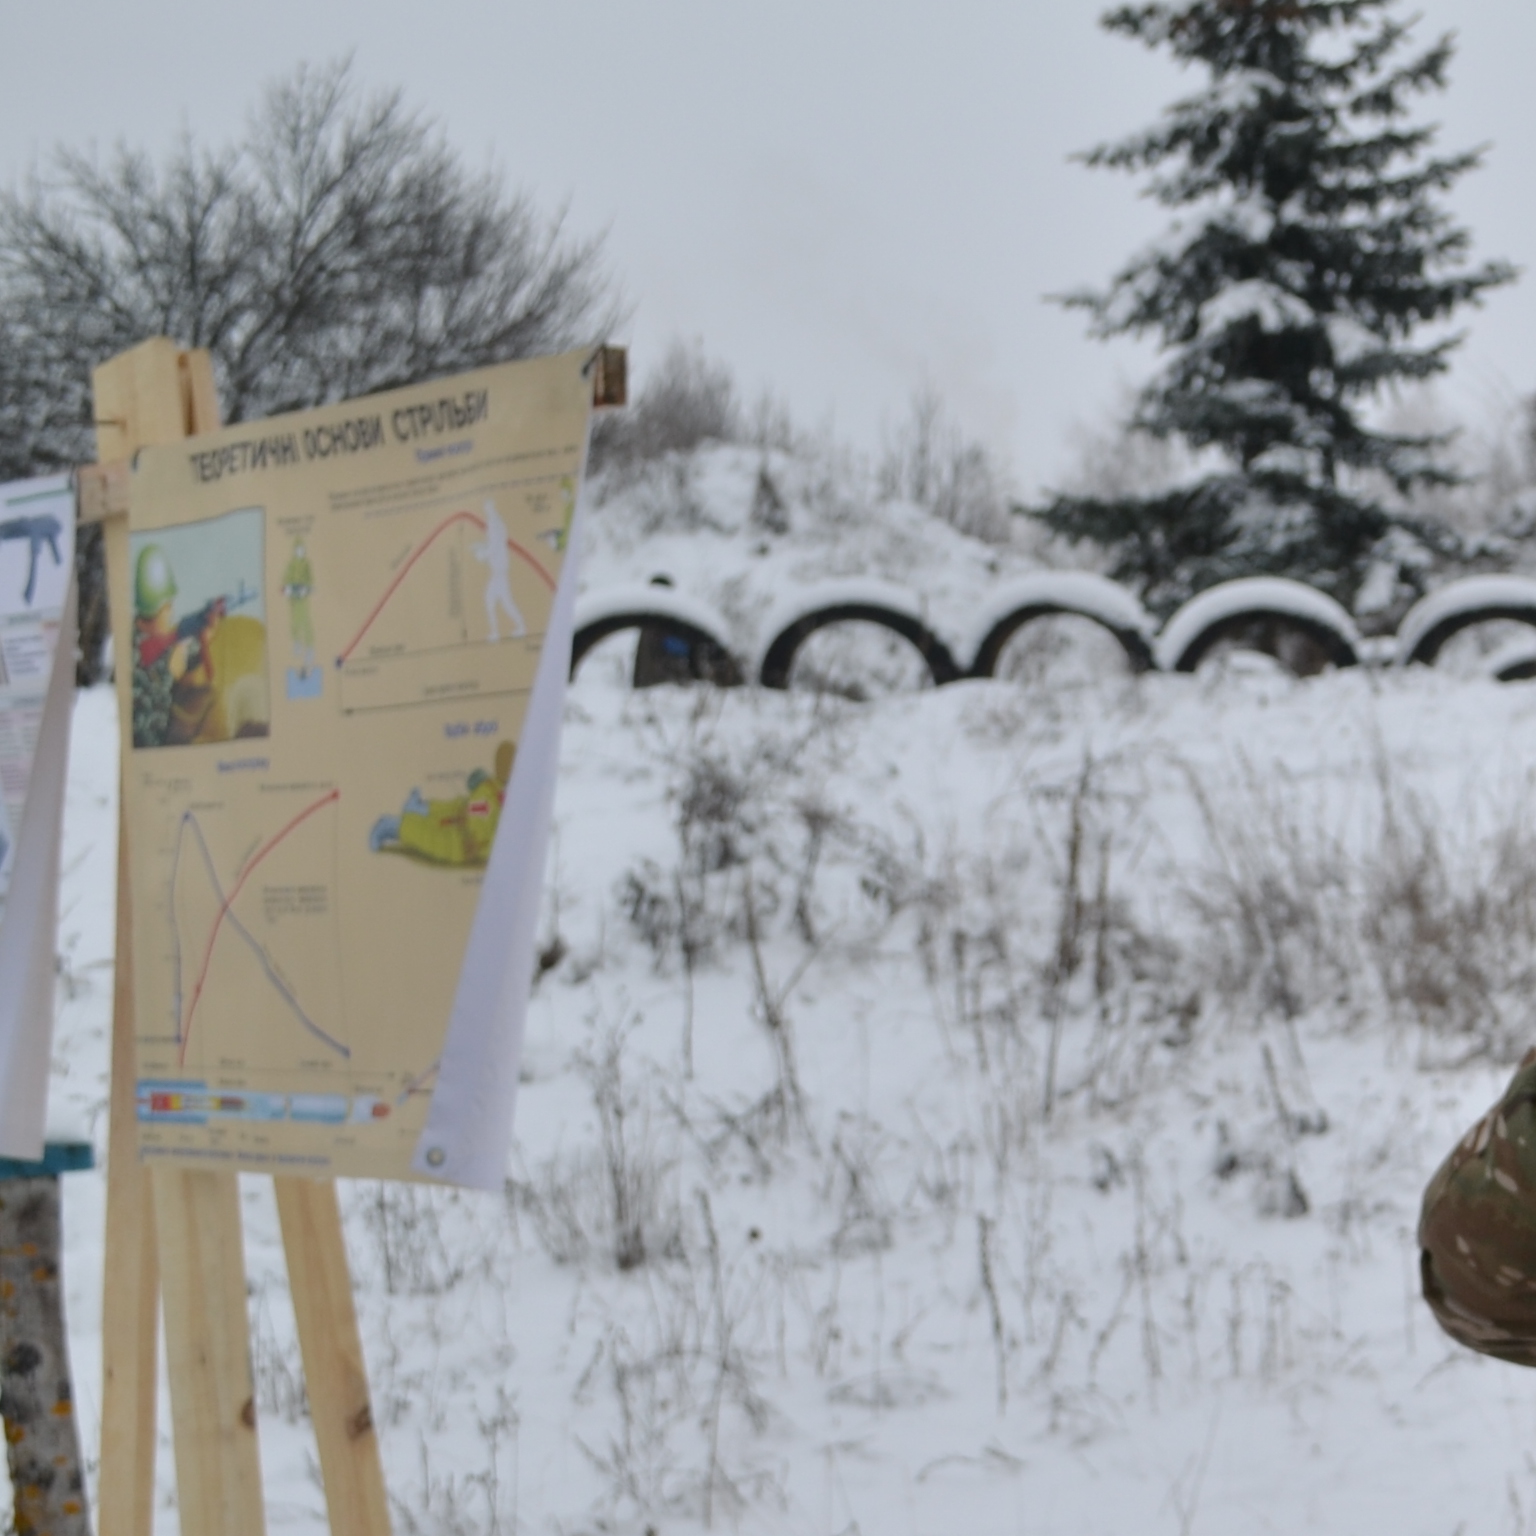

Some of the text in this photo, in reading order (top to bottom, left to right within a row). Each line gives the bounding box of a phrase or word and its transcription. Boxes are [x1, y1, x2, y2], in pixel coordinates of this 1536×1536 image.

[190, 432, 299, 483] ТЕОРЕТИЧНІ
[303, 415, 385, 460] ОСНОВИ
[391, 388, 488, 442] СТРІЛЬБИ
